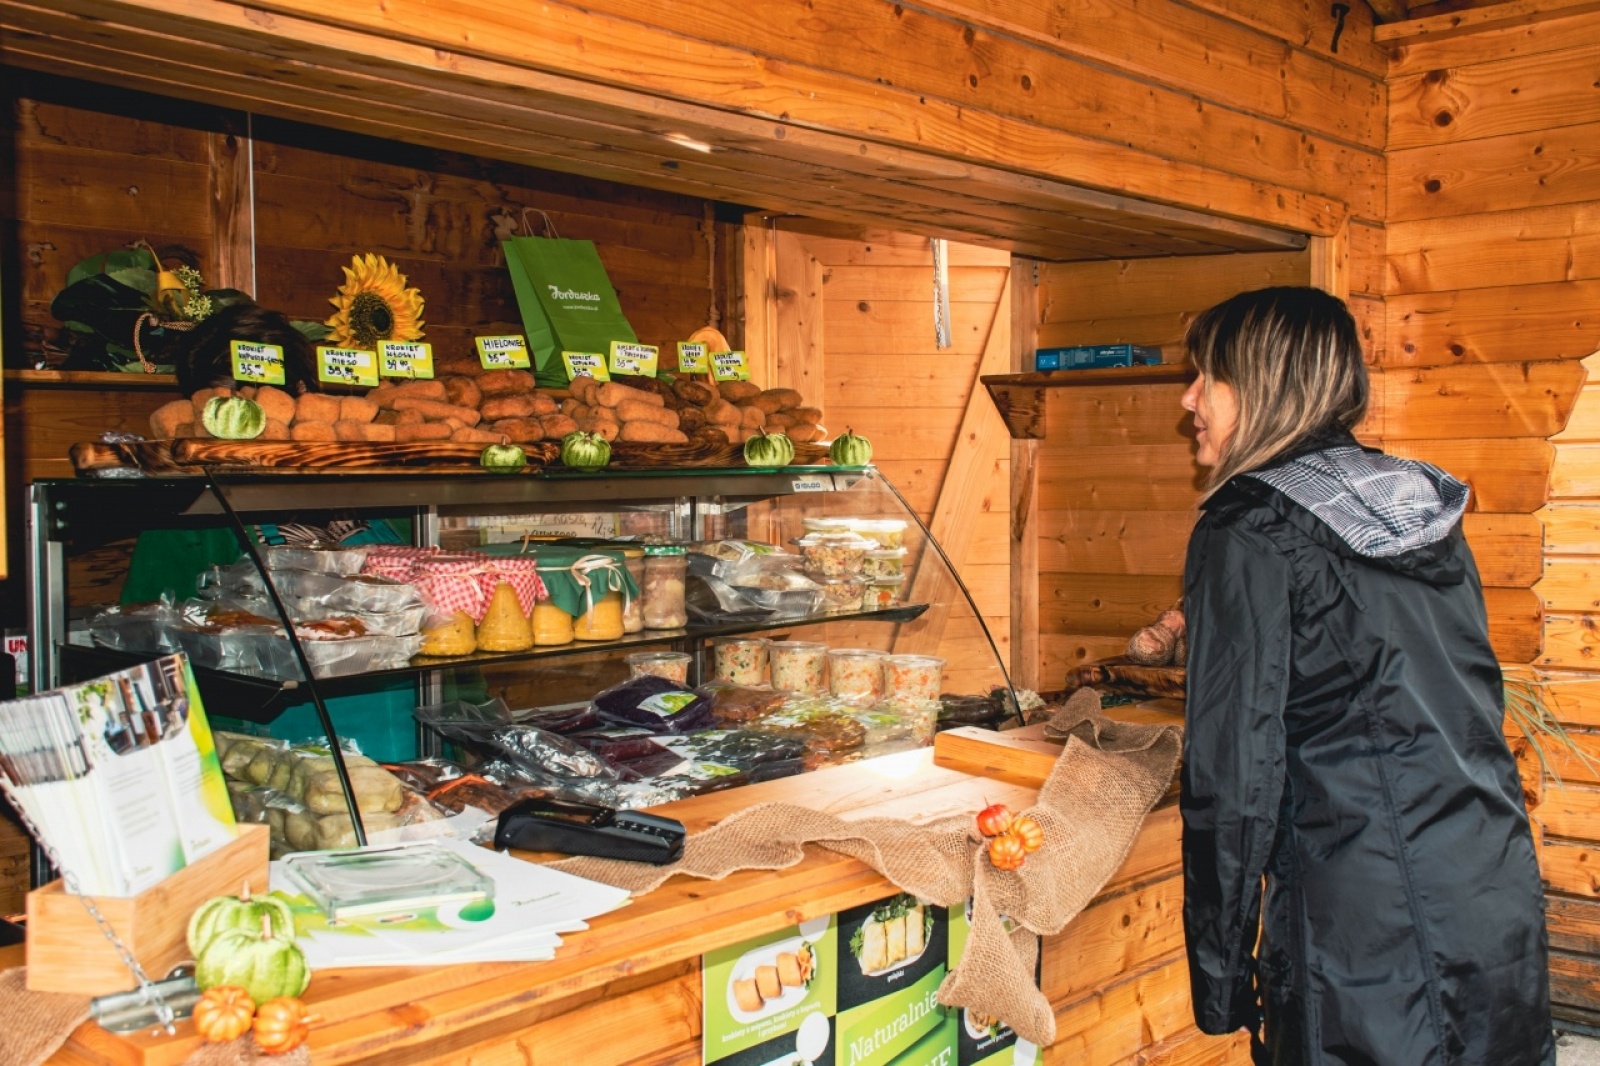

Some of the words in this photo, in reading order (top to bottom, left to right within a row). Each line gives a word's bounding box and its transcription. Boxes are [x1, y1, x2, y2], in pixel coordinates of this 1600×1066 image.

[385, 344, 419, 352] KROKIET
[325, 349, 358, 358] KROKIET
[848, 990, 938, 1066] Naturalnie
